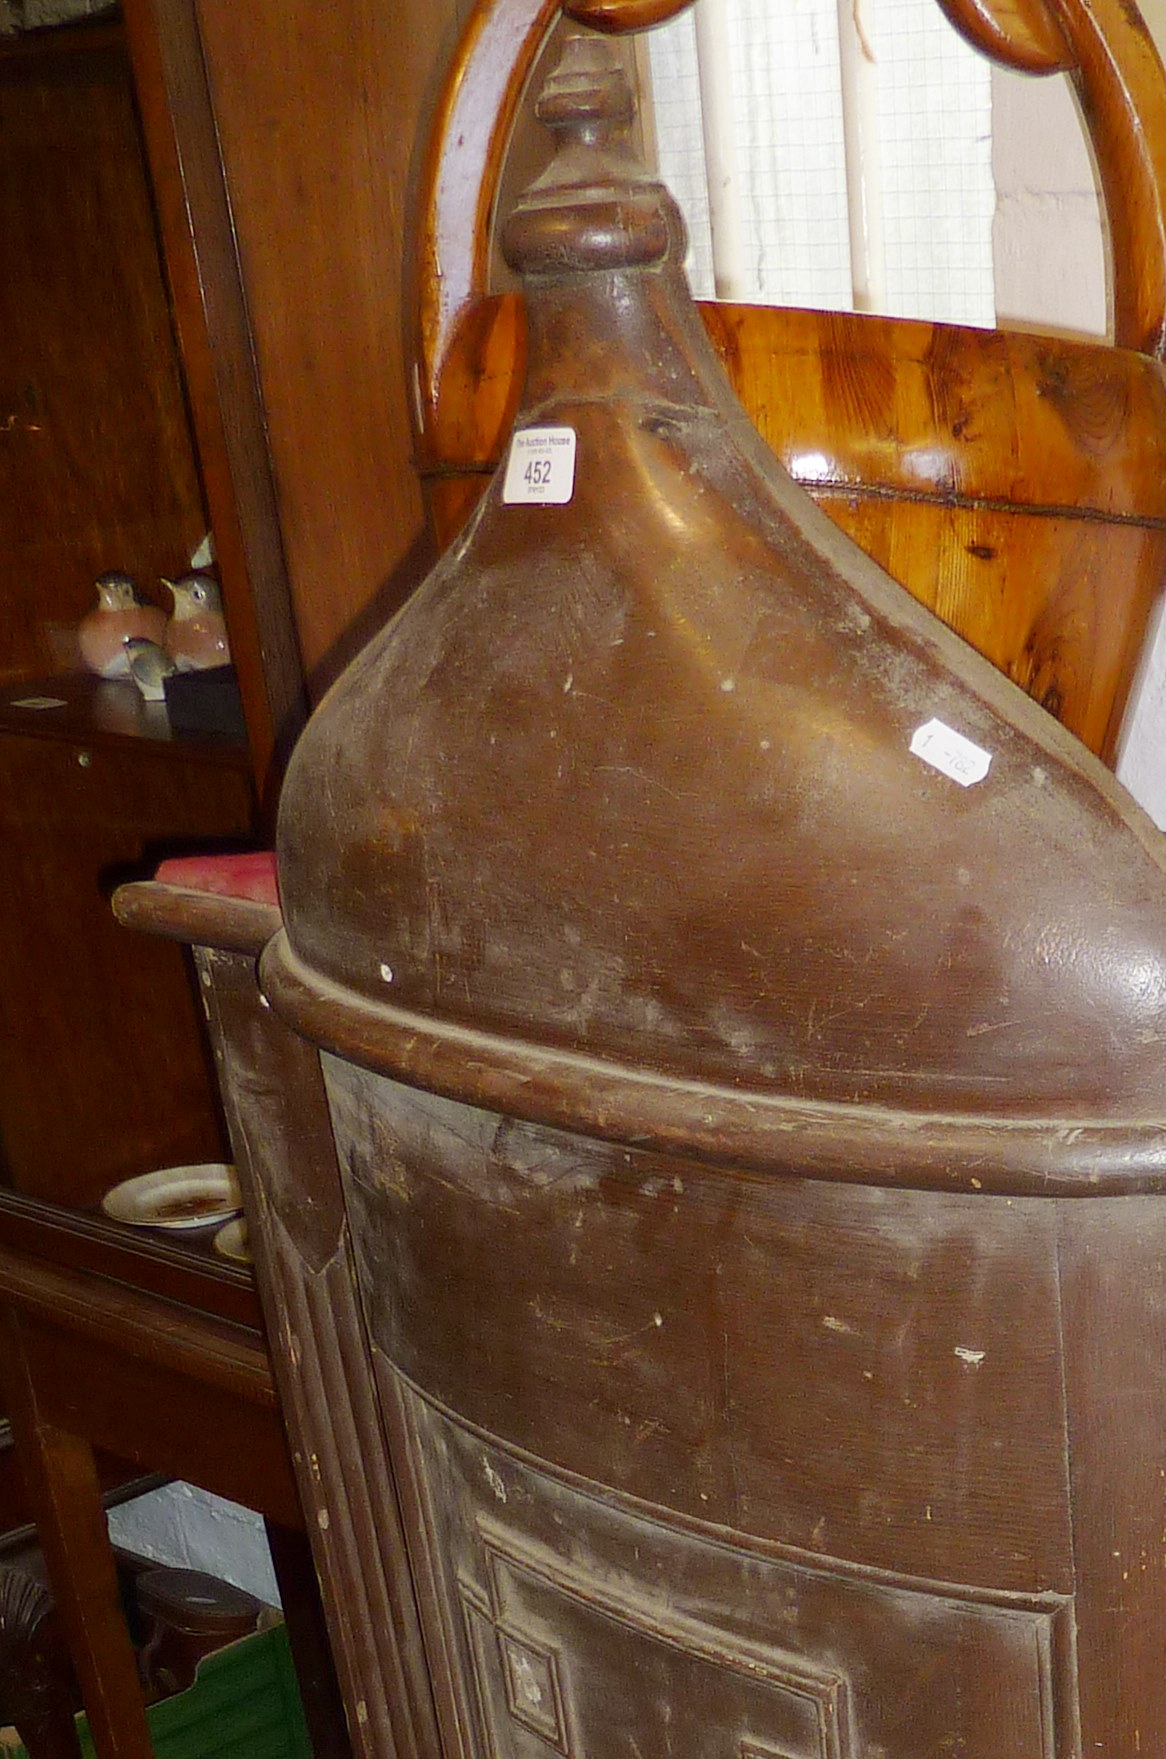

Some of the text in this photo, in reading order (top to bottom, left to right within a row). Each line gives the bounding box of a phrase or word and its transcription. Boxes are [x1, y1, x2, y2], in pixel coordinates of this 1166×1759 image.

[526, 437, 547, 447] Auction
[549, 436, 571, 446] House
[524, 460, 552, 485] 452
